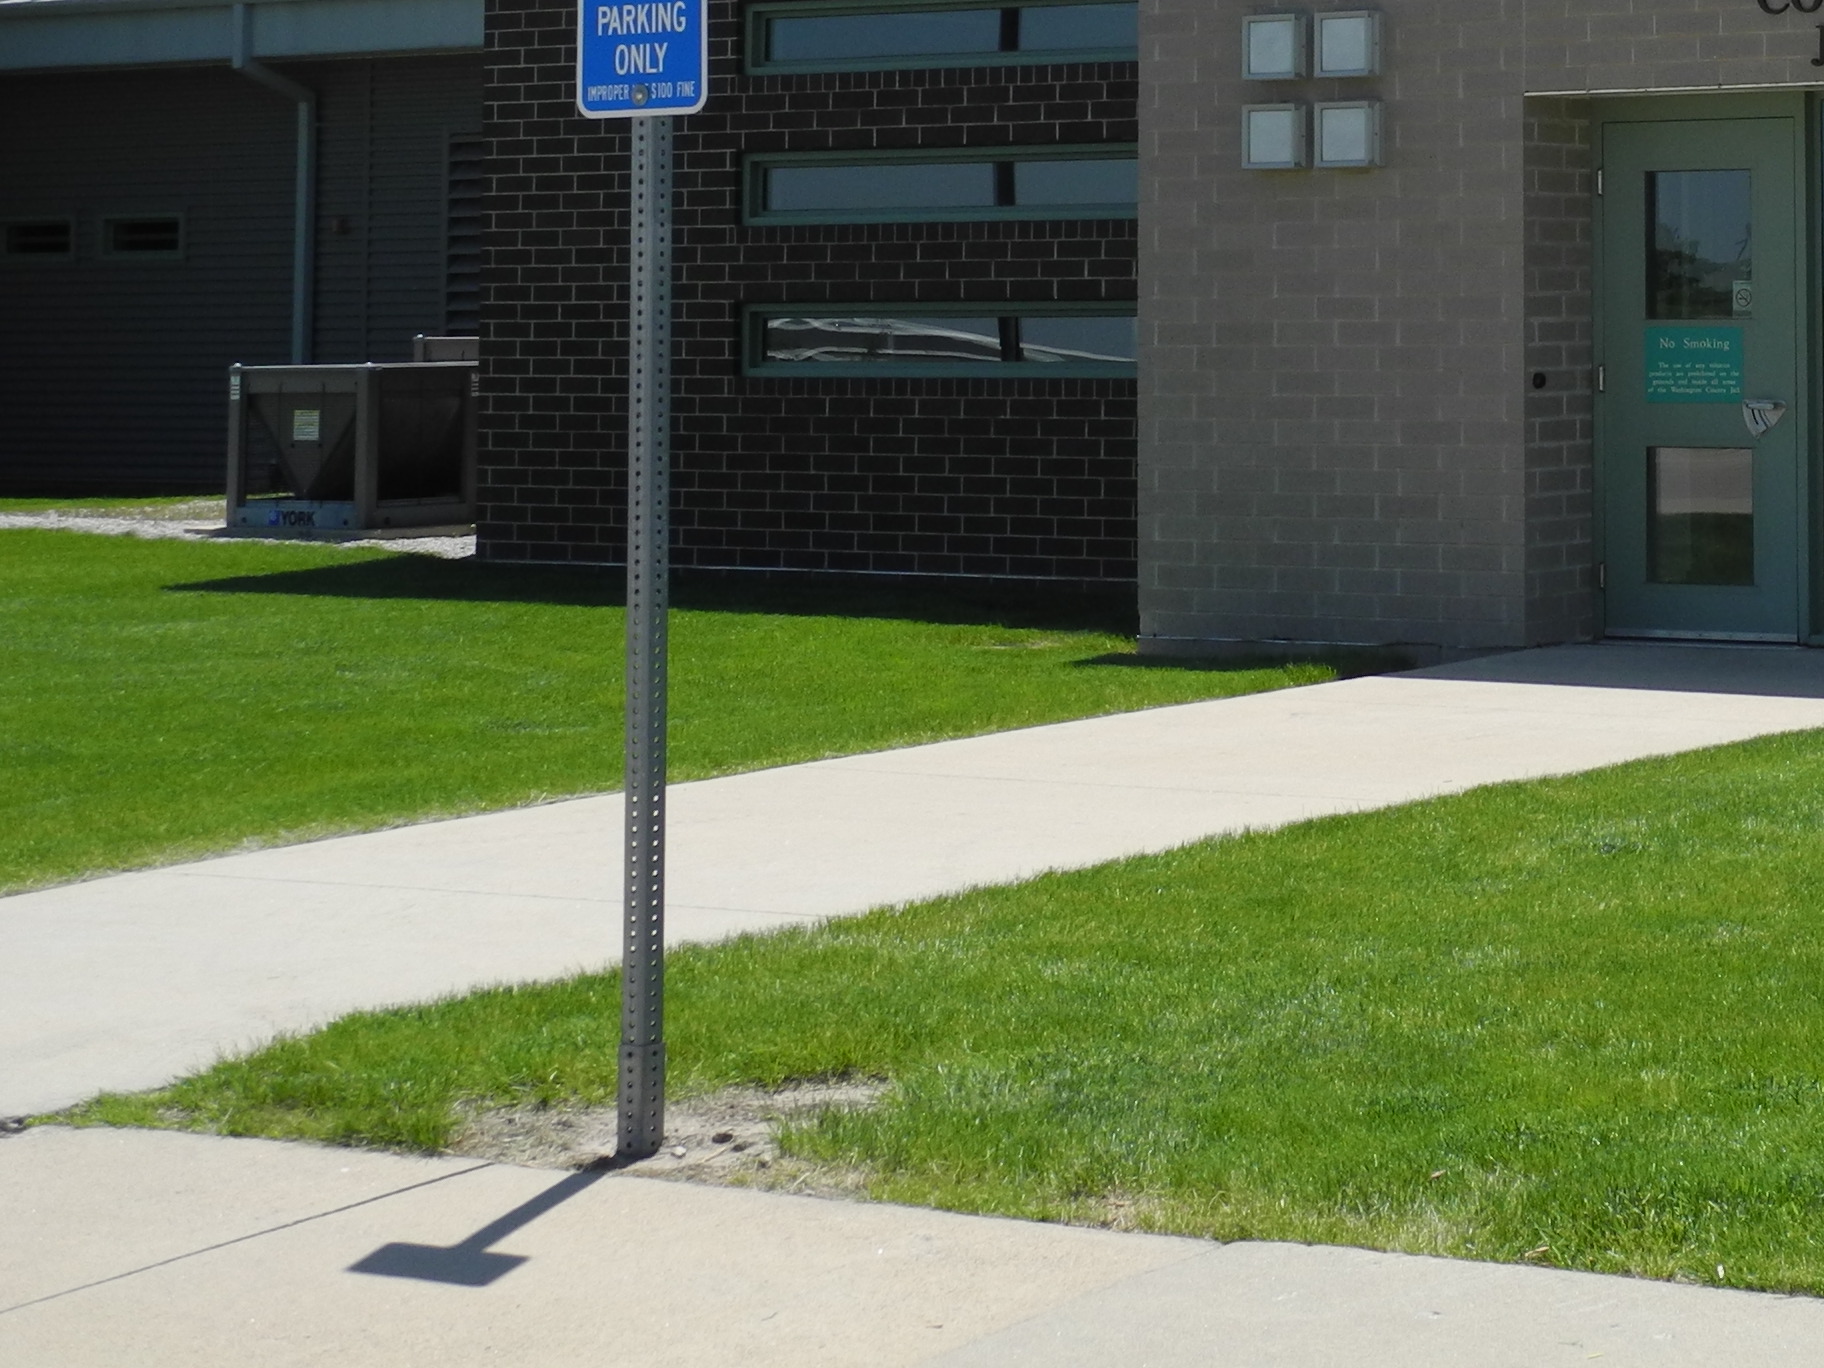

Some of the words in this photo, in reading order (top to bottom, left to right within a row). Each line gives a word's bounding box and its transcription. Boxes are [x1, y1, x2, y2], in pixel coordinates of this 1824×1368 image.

[597, 1, 687, 36] PARKING
[614, 42, 668, 75] ONLY
[587, 84, 630, 102] IMPROPER
[676, 81, 696, 97] FINE
[1659, 337, 1675, 349] No
[1683, 337, 1730, 351] Smoking
[280, 510, 316, 526] YORK
